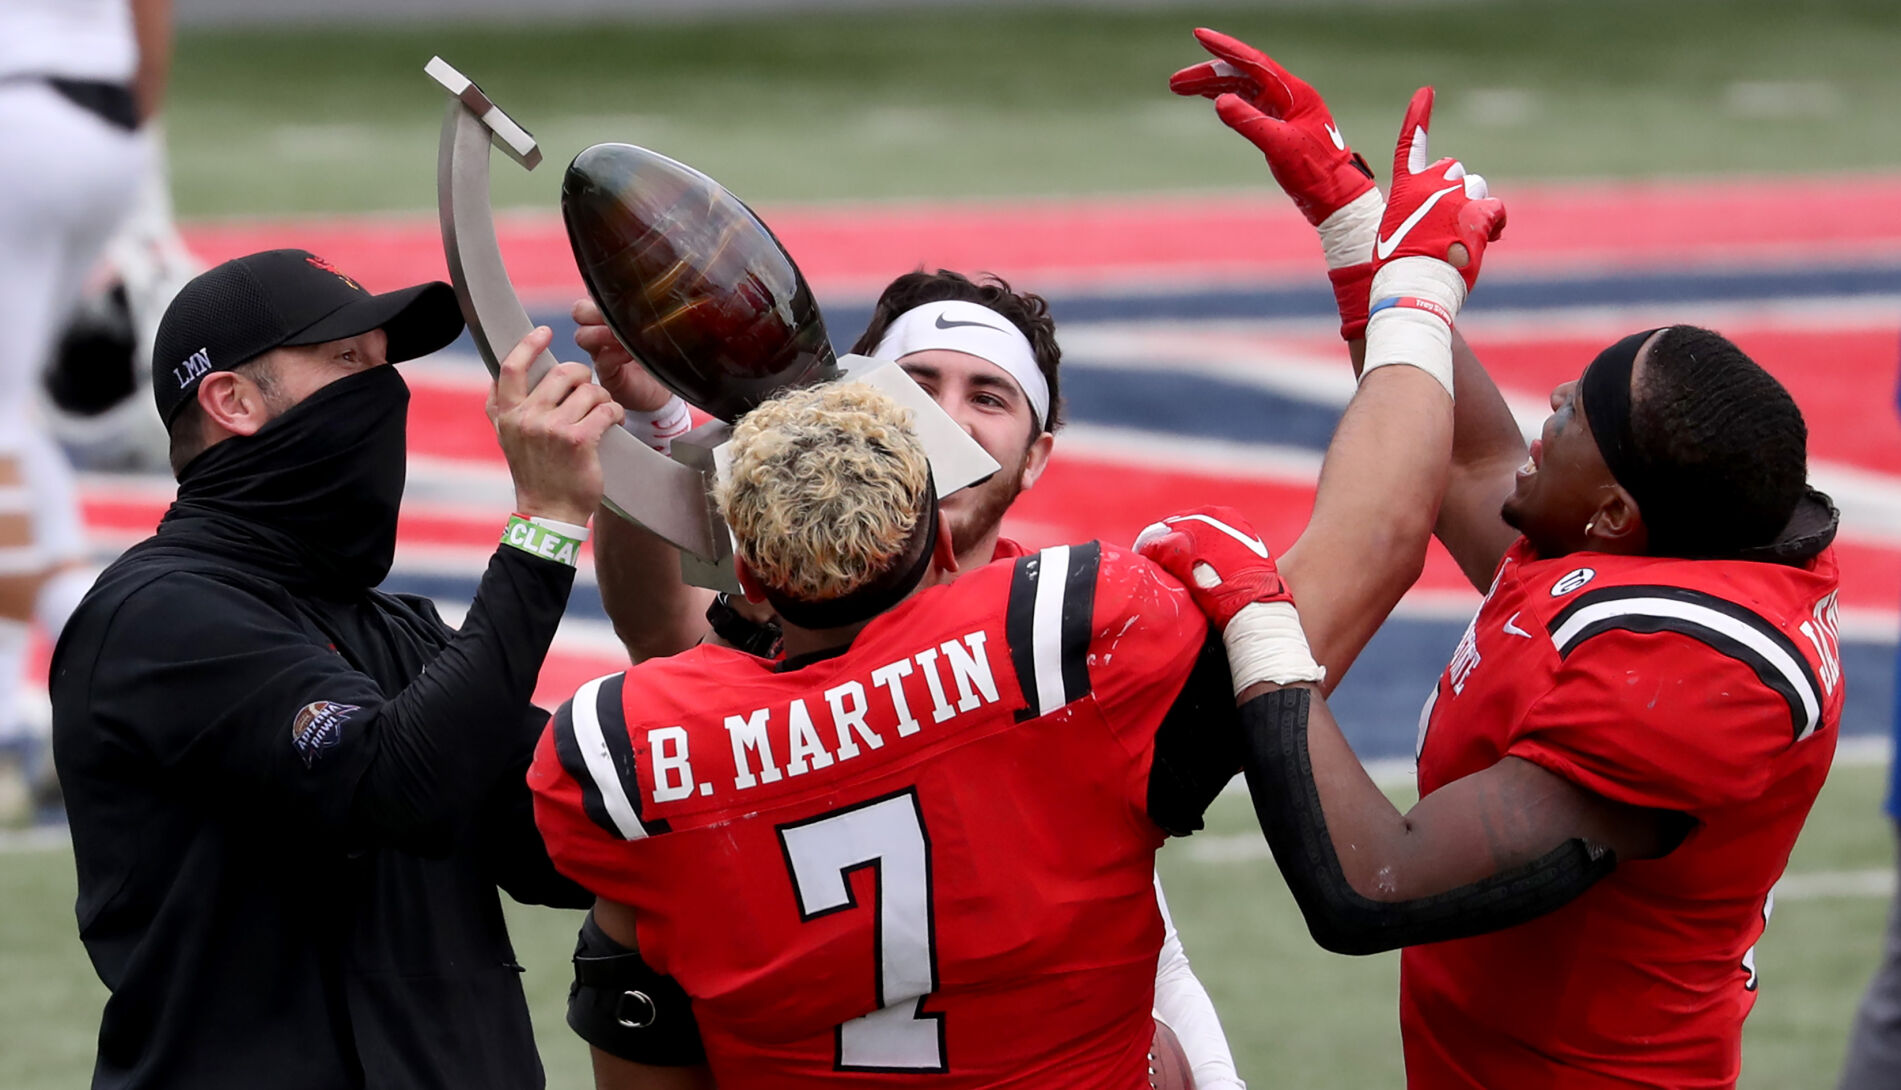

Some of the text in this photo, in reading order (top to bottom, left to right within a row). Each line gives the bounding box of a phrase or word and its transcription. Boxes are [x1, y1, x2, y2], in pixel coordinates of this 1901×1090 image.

[173, 346, 212, 389] LMN
[510, 523, 579, 567] CLEA
[647, 629, 1001, 804] B. MARTIN
[774, 784, 950, 1074] 7
